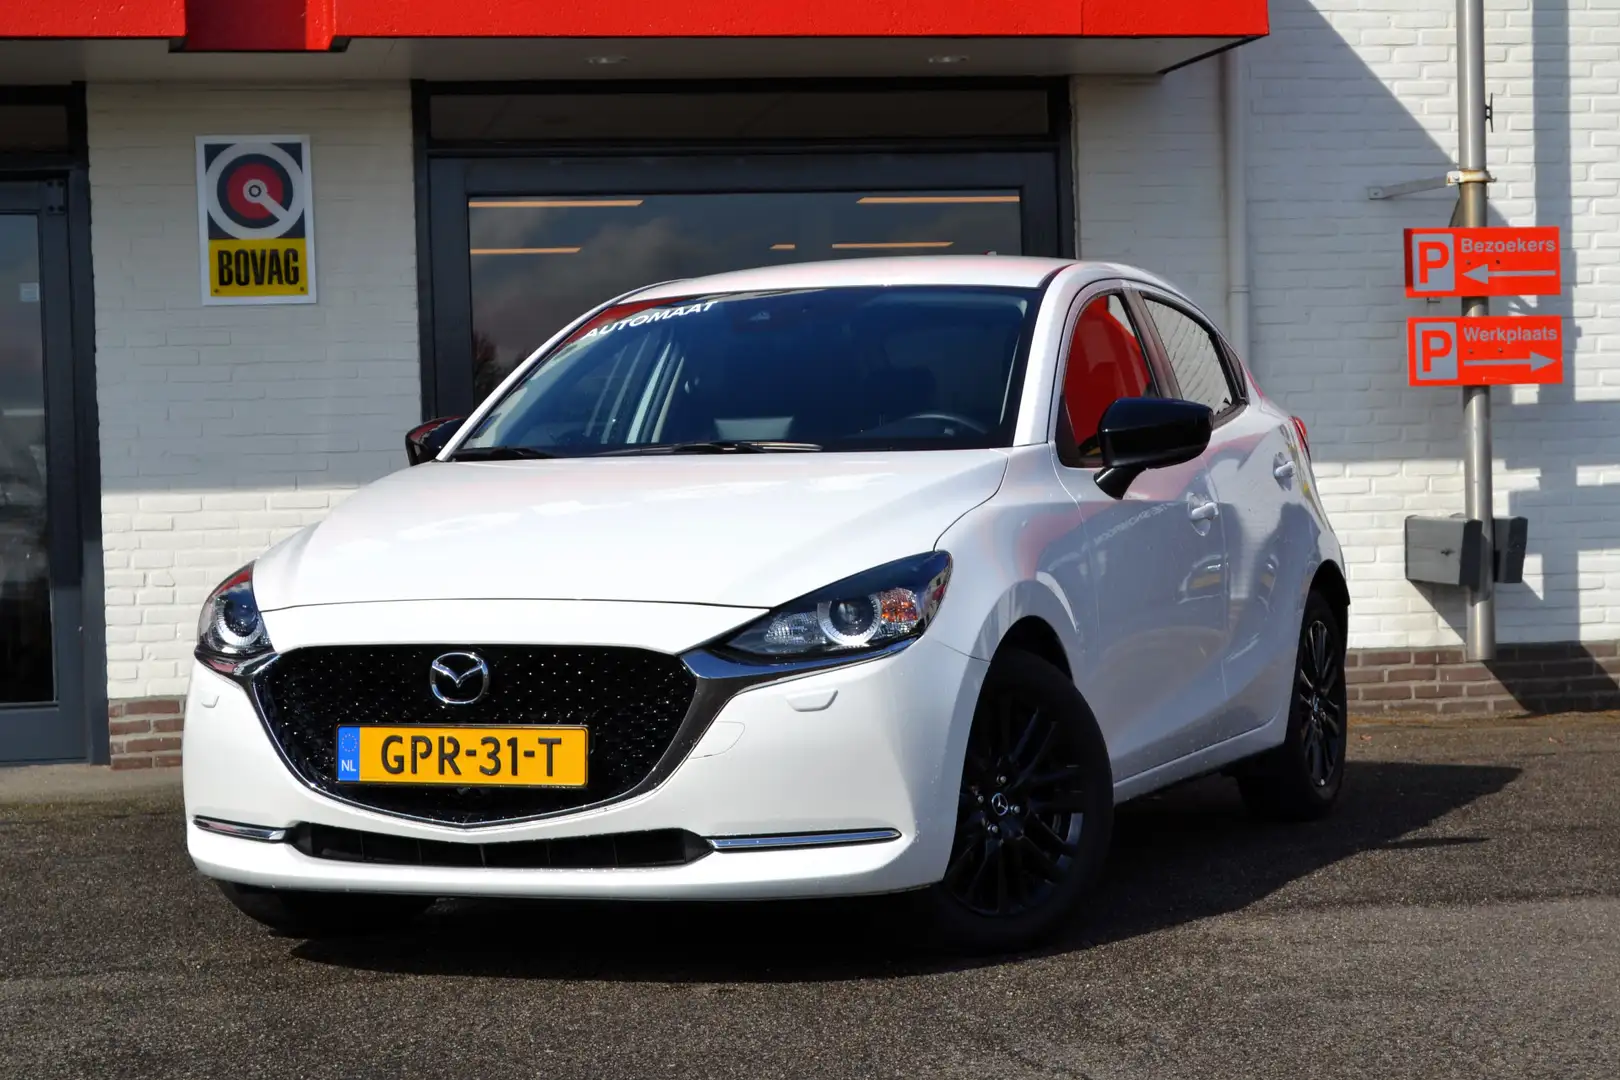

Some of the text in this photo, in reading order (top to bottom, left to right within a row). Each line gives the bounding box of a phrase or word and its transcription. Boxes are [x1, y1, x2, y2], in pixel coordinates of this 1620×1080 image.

[217, 248, 300, 287] BOVAG
[1418, 237, 1556, 284] P Bezoekers
[578, 300, 719, 341] AUTOMAAT
[1421, 326, 1558, 373] P Werkplaats
[341, 734, 562, 777] NL GPR-31-T
